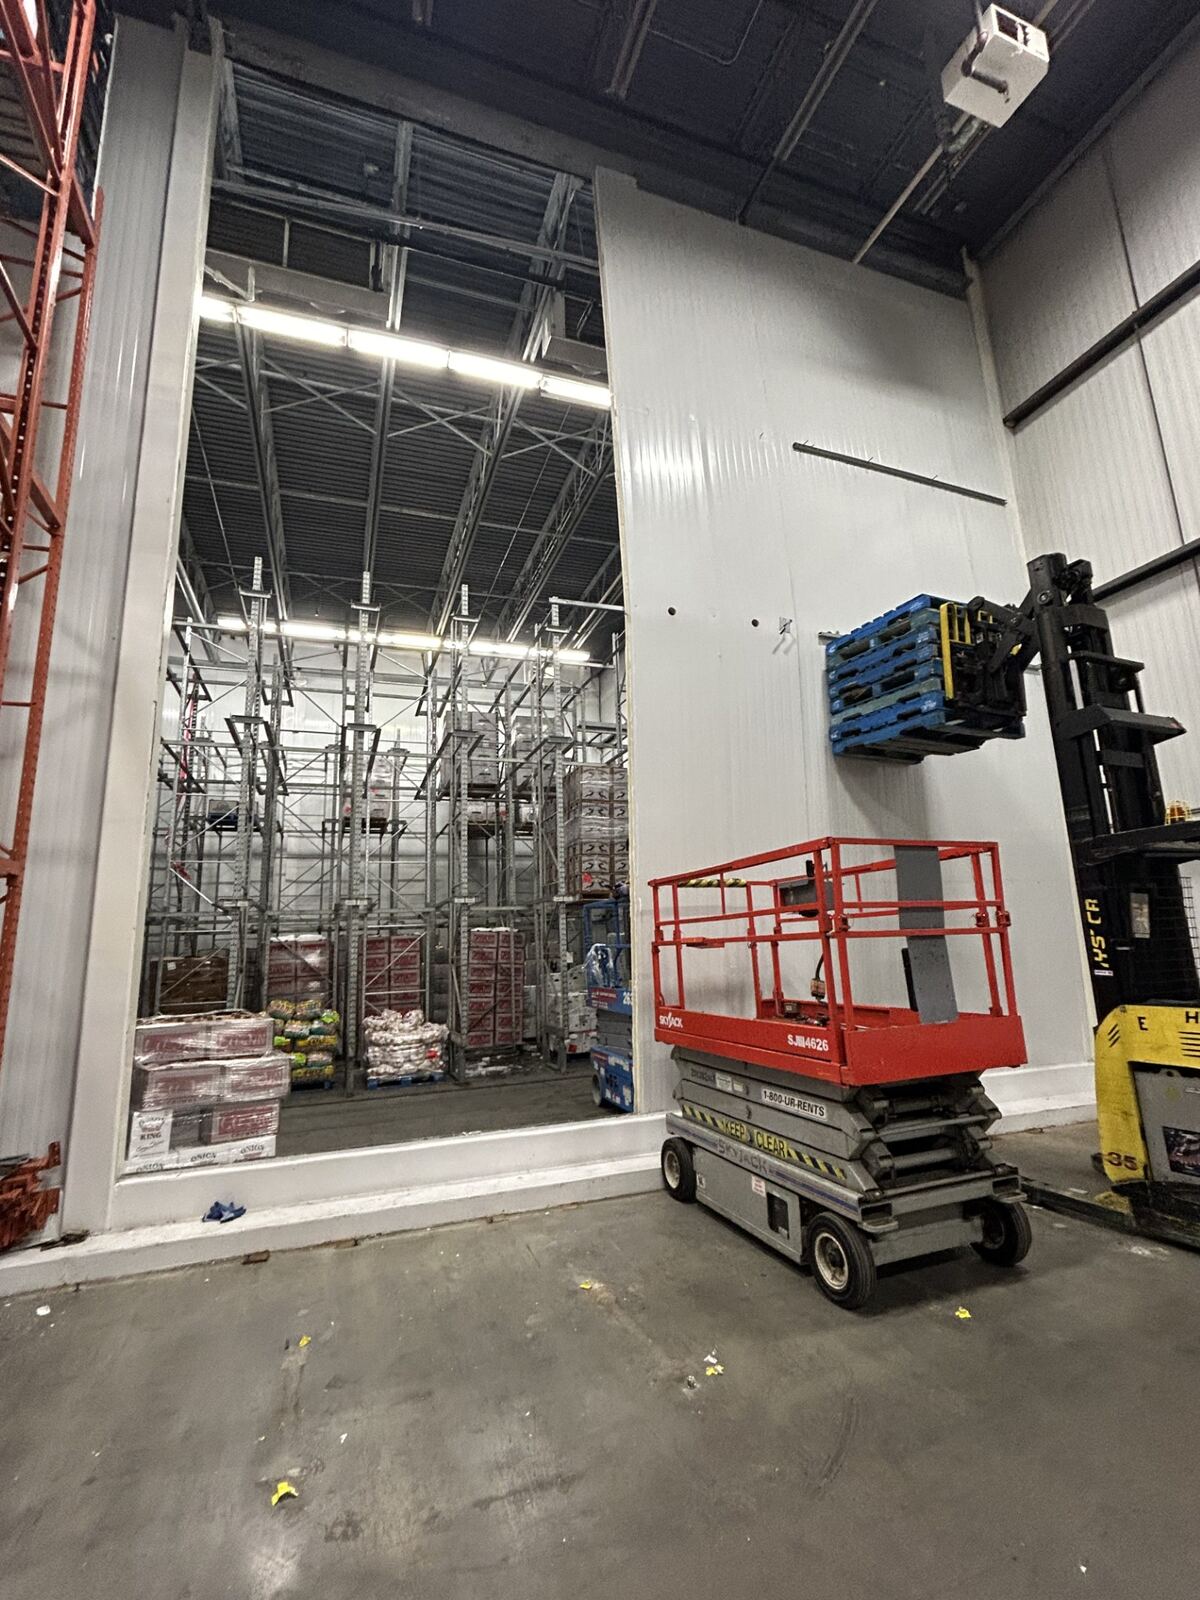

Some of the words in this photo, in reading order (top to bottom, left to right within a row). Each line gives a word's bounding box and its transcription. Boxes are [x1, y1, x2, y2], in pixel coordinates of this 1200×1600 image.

[1137, 1016, 1149, 1031] E
[1185, 1011, 1199, 1024] H
[763, 1089, 825, 1117] 1-800-UR-RENTS
[723, 1119, 745, 1139] KEEP
[755, 1131, 785, 1157] CLEAR
[1107, 1151, 1139, 1171] 35
